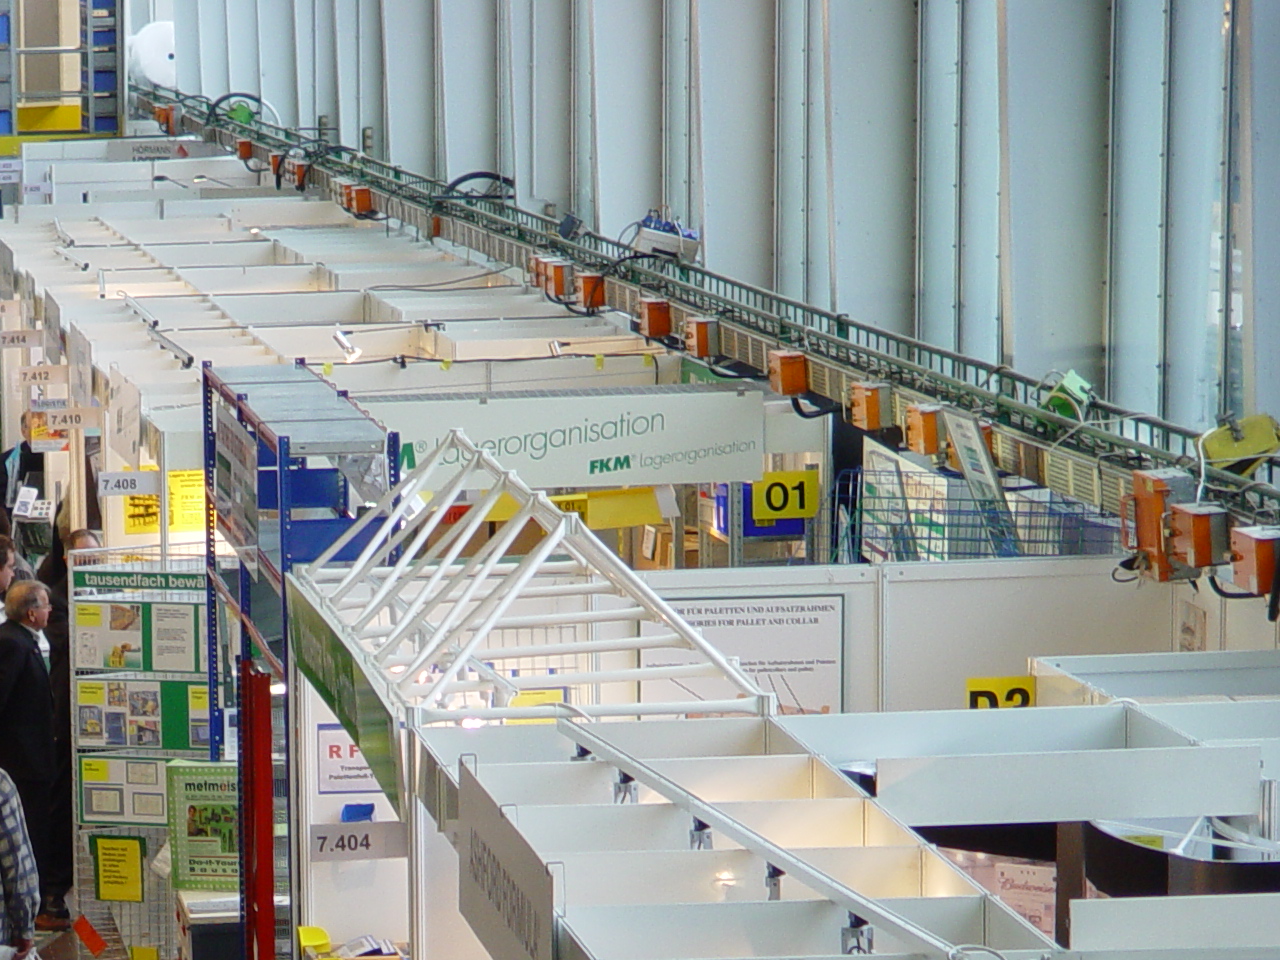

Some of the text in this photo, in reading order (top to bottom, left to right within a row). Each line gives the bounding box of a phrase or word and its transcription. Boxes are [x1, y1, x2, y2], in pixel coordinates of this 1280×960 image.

[1, 335, 27, 344] 7.414
[22, 370, 50, 381] 7.412
[51, 414, 81, 425] 7.410
[639, 440, 756, 470] Lagerorganisation
[102, 477, 137, 490] 7.408
[84, 573, 206, 588] tausendfach bewä
[317, 833, 371, 852] 7.404
